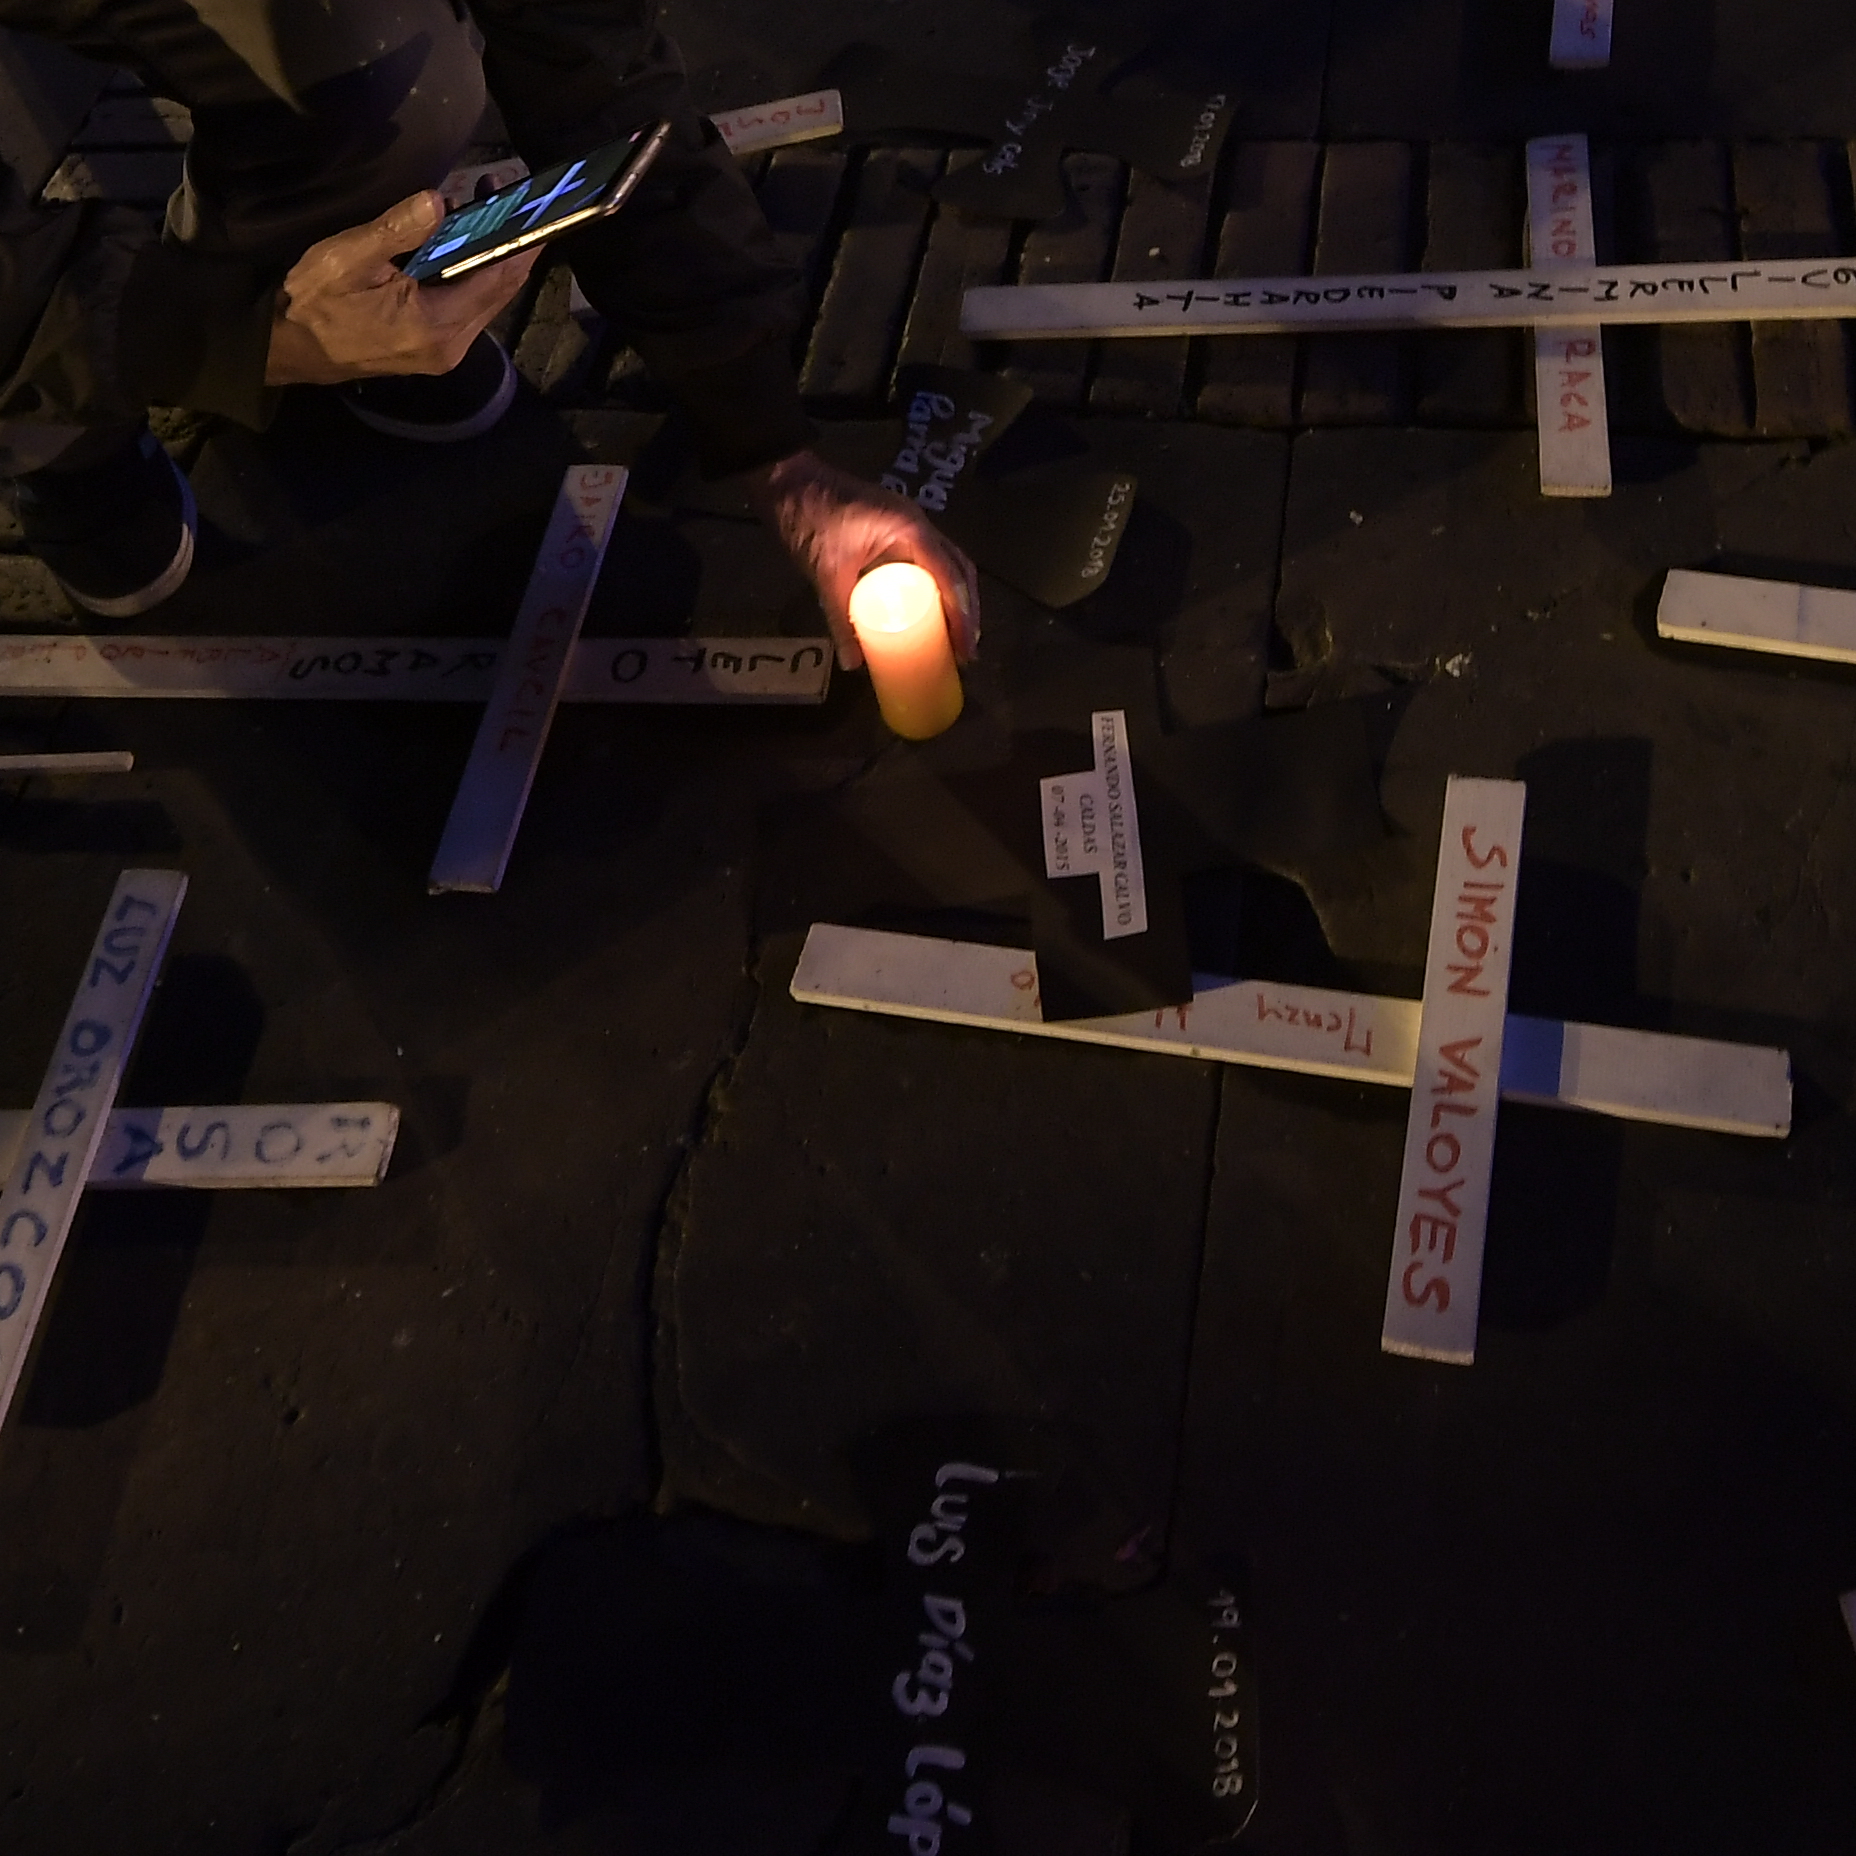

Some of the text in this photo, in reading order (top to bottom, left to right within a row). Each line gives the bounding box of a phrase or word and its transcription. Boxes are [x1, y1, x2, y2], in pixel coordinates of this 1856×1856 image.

[1077, 794, 1099, 852] CALDAS
[1100, 716, 1135, 929] FERNANDO SALAZAR CALVO
[90, 898, 169, 987] LUZ
[1400, 1035, 1488, 1312] VALOYES
